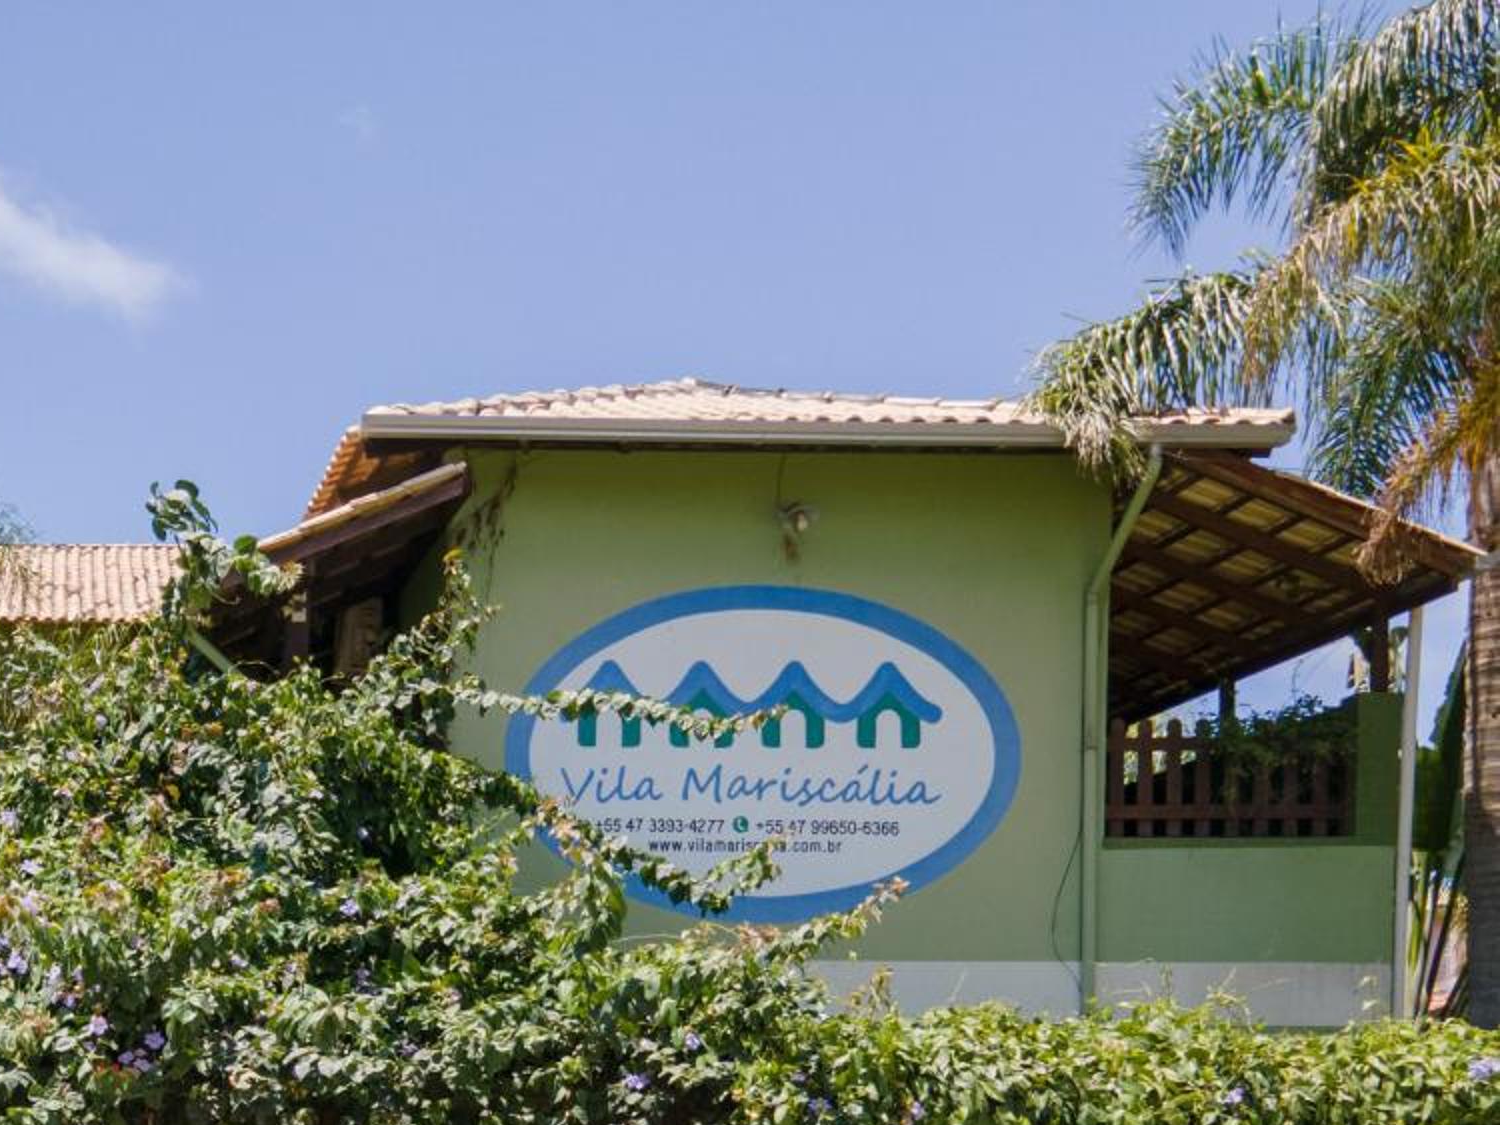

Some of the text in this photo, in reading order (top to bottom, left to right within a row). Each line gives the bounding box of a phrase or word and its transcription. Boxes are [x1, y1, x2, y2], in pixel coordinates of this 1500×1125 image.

[560, 763, 942, 807] Vila Mariscália
[625, 816, 644, 833] 47
[649, 818, 725, 833] 3393-4277
[756, 819, 784, 834] +55
